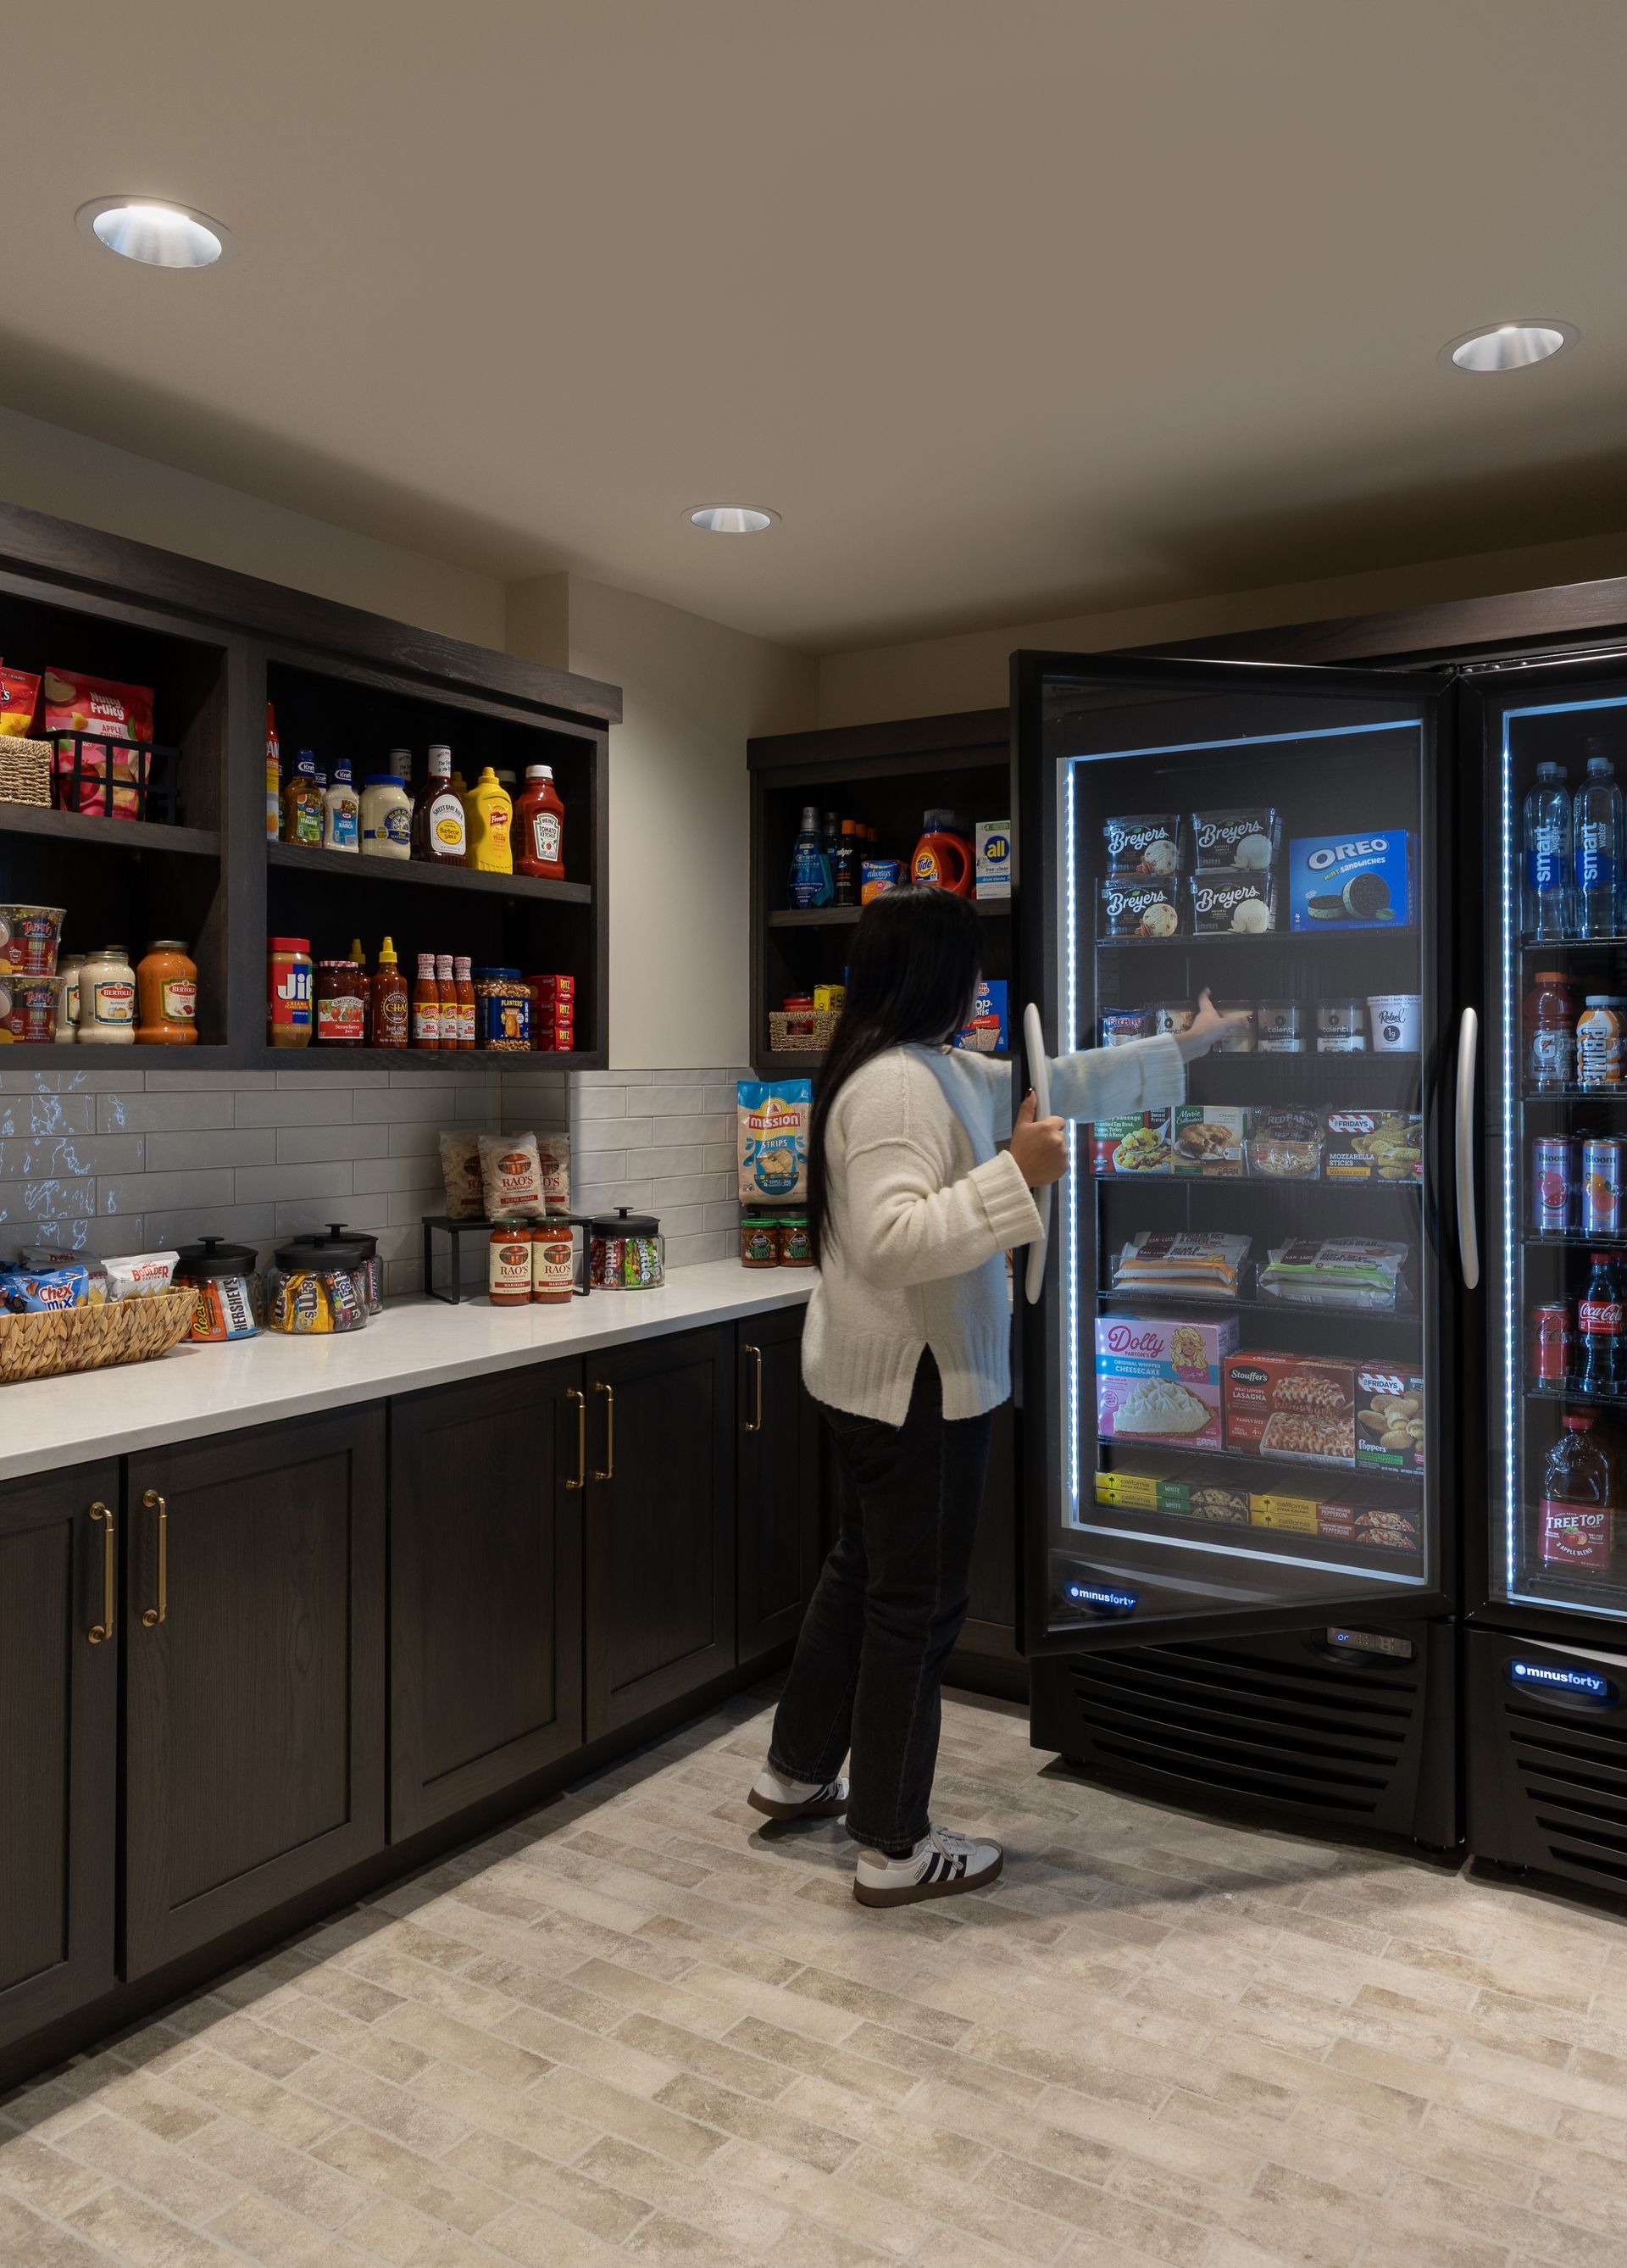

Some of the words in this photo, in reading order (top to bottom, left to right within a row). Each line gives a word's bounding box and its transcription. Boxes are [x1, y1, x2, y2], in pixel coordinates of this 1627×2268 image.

[90, 702, 125, 720] Fruity
[102, 725, 122, 735] APPLE
[440, 827, 460, 836] Barbecue
[1198, 820, 1264, 848] Breyers
[1597, 822, 1607, 848] water
[1108, 826, 1170, 854] Breyers
[986, 840, 1006, 858] all
[1308, 838, 1388, 870] OREO
[1534, 825, 1551, 882] smart
[1581, 822, 1598, 880] smart
[917, 859, 933, 873] Tide
[867, 868, 891, 879] always
[1106, 890, 1169, 916] Breyers
[1196, 885, 1261, 913] Breyers
[277, 974, 312, 1000] Jif
[559, 978, 571, 990] RITZ
[559, 1004, 569, 1014] RITZ
[1379, 1008, 1406, 1024] Rebel
[558, 1030, 569, 1040] RITZ
[1388, 1027, 1397, 1038] 1g
[1533, 1034, 1556, 1059] G
[1581, 1027, 1608, 1082] PRIME
[1267, 1115, 1285, 1126] RED
[1286, 1113, 1314, 1127] BARON
[761, 1139, 788, 1148] STRIPS
[1538, 1153, 1568, 1162] Bloom
[1585, 1153, 1617, 1164] Bloom
[502, 1176, 534, 1187] RAO'S
[131, 1265, 169, 1281] BOULDER
[500, 1265, 529, 1275] RAO'S
[545, 1265, 571, 1274] RAO'S
[39, 1282, 75, 1303] Chex
[224, 1276, 248, 1331] HERSHEY'S
[1108, 1325, 1165, 1359] Dolly
[1115, 1366, 1160, 1376] CHEESECAKE
[1230, 1369, 1268, 1382] Stouffer's
[1368, 1380, 1398, 1389] FRIDAYS
[1233, 1391, 1267, 1402] LASAGNA
[1358, 1439, 1387, 1453] Poppers
[1120, 1479, 1150, 1488] california
[1121, 1494, 1151, 1504] california
[1276, 1500, 1309, 1510] california
[1320, 1509, 1348, 1519] PEPPERONI
[1278, 1518, 1311, 1527] california
[1546, 1516, 1579, 1529] TREE
[1579, 1514, 1605, 1526] TOP
[1322, 1526, 1350, 1536] PEPPERONI
[1560, 1545, 1576, 1555] APPLE
[1576, 1548, 1593, 1556] BLEND
[1079, 1589, 1135, 1608] minusforty
[1526, 1667, 1600, 1690] minusforty
